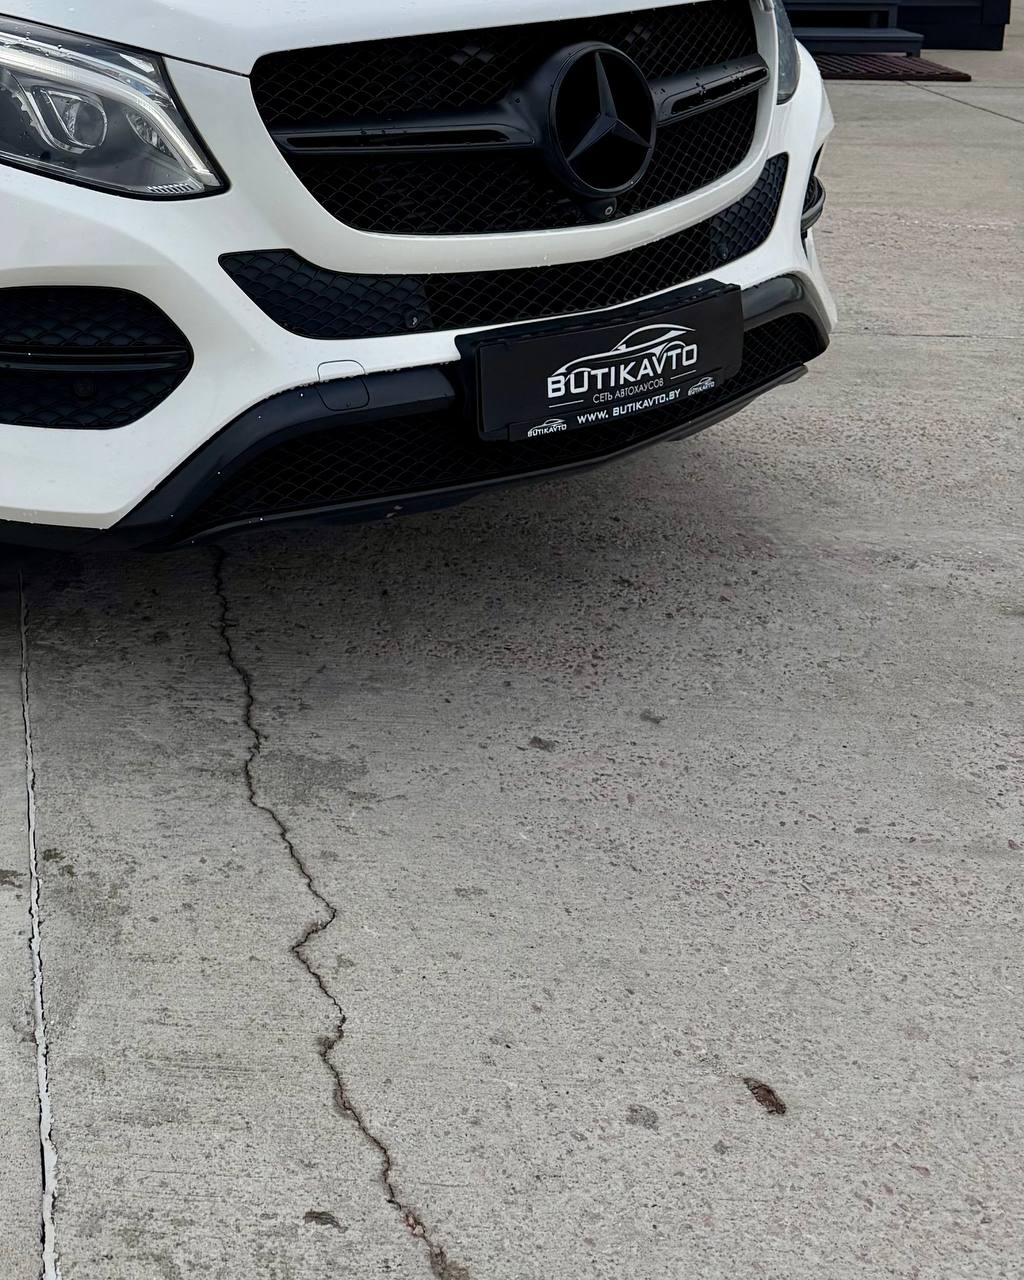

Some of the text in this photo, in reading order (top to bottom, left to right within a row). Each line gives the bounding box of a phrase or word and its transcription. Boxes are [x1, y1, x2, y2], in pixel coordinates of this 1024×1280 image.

[547, 344, 698, 399] BUTIKAVTO
[592, 378, 664, 404] СЕТЬ АВТОХАУСОВ
[687, 380, 715, 396] BUTIKAVTO
[577, 388, 681, 424] WWW. BUTIKAVTO.BY
[527, 423, 567, 438] BUTIKAVTO
